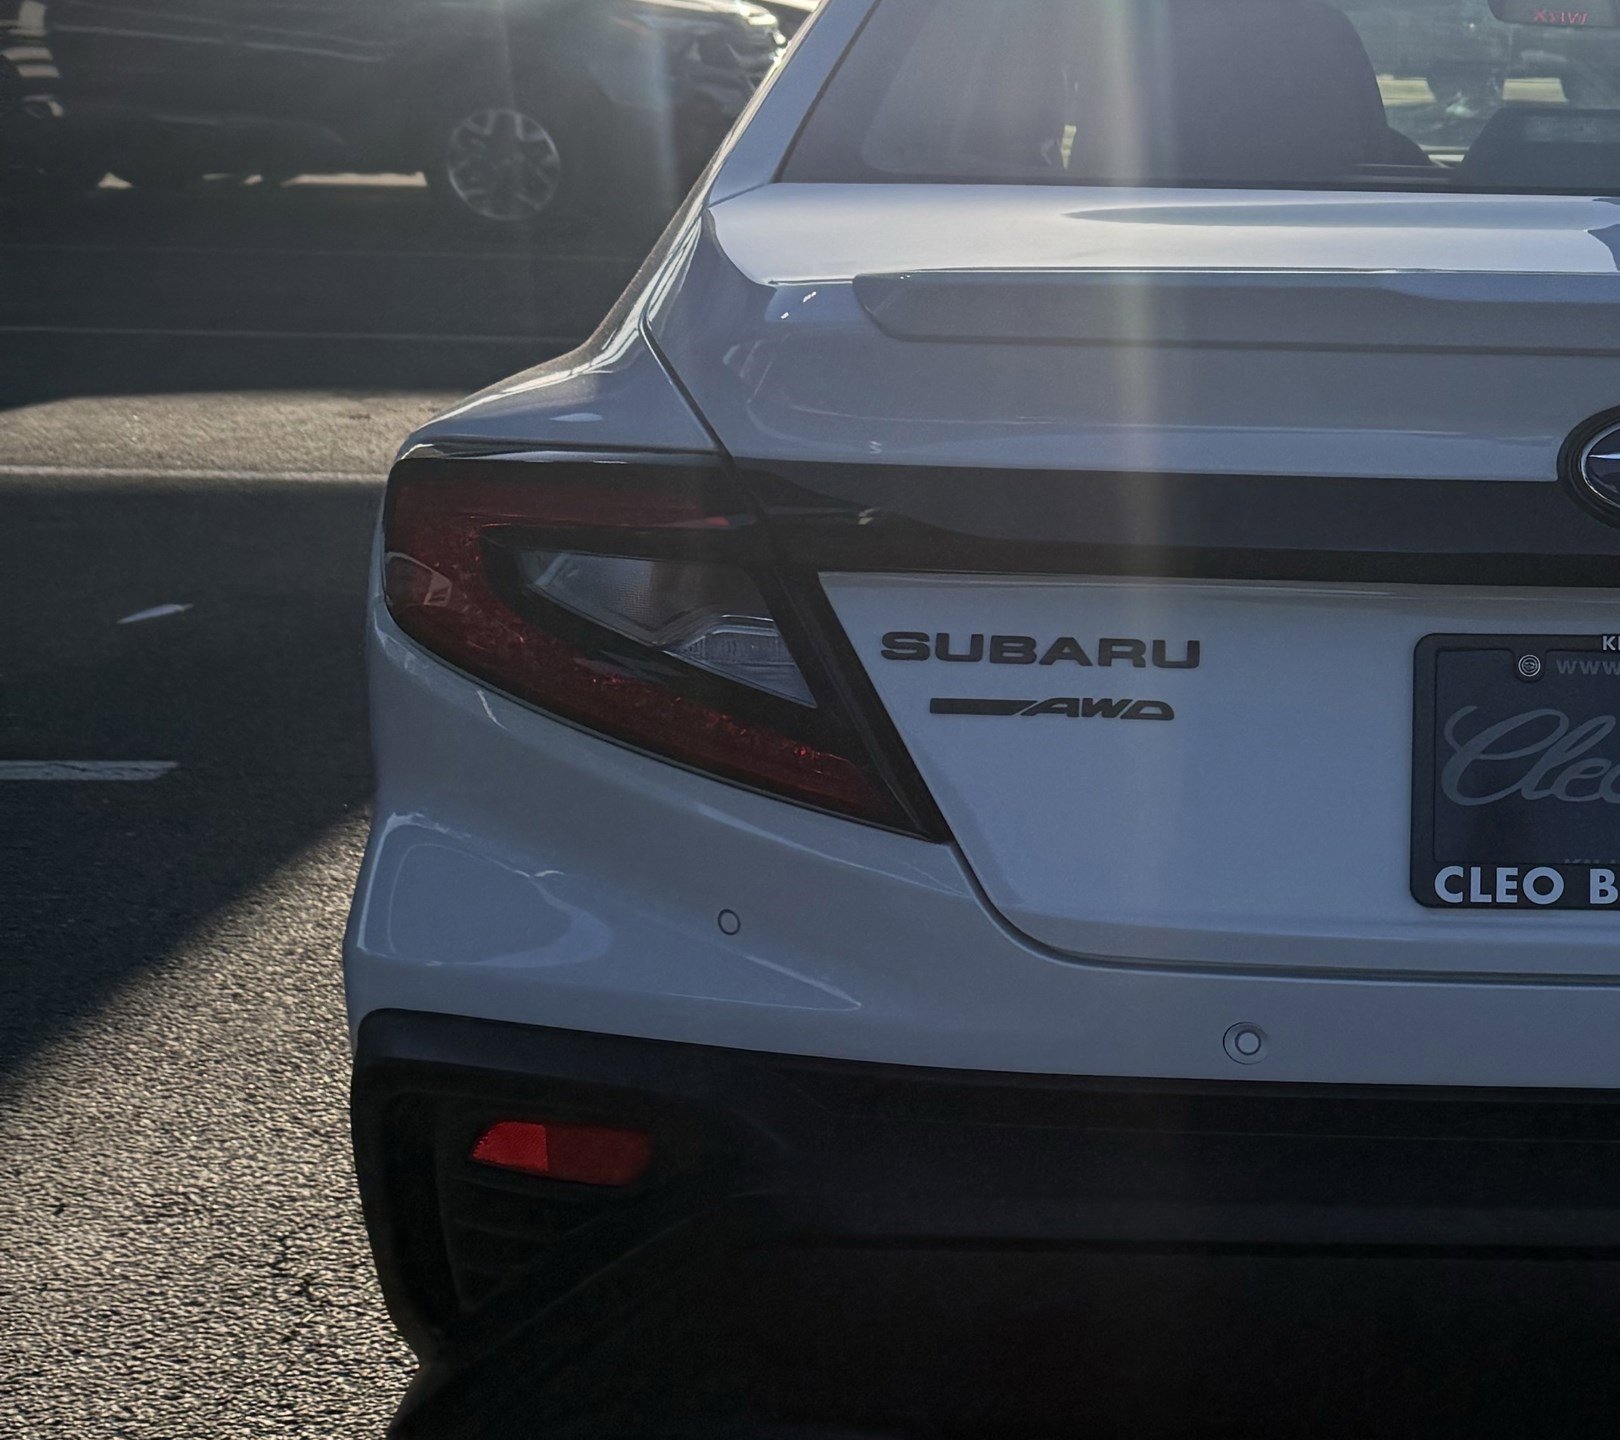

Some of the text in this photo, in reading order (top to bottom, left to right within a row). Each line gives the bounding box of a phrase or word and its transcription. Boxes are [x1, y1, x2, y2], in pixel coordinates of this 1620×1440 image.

[881, 631, 1200, 669] SUBARU
[1020, 697, 1175, 721] AWD
[1434, 866, 1565, 905] CLEO
